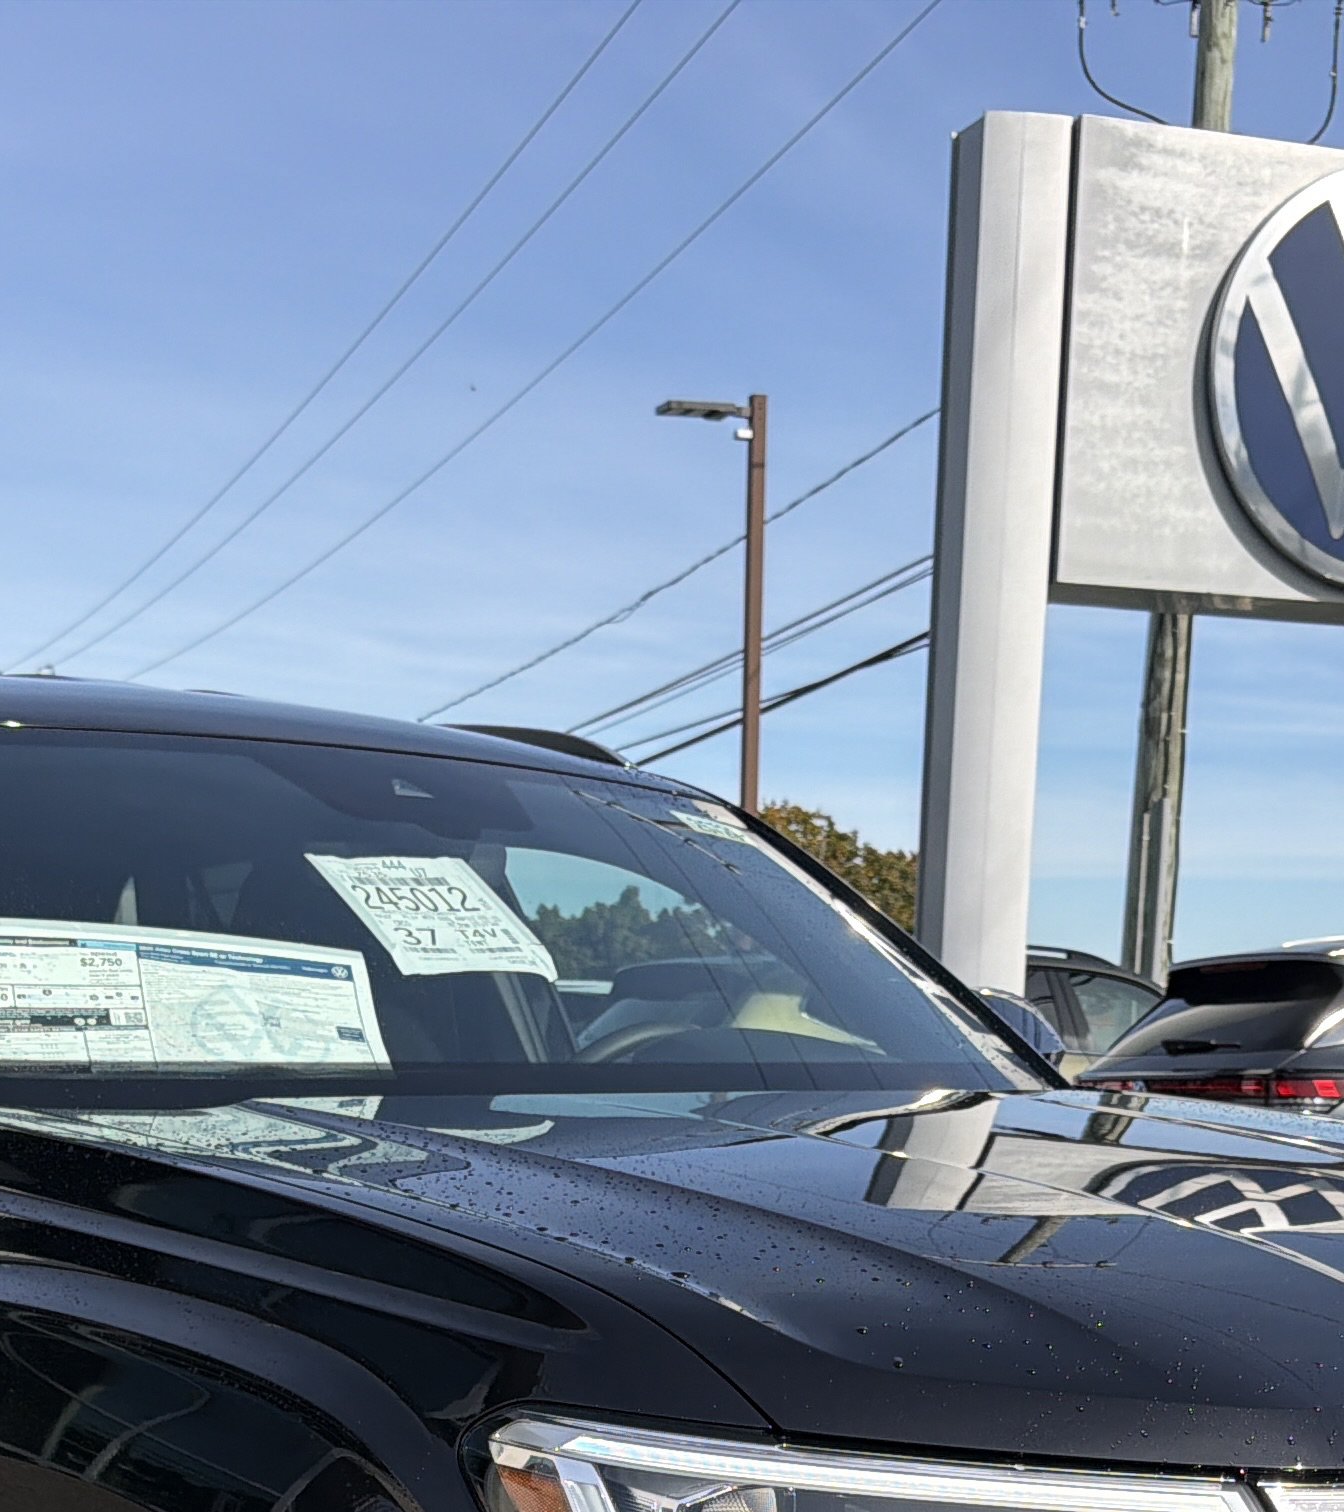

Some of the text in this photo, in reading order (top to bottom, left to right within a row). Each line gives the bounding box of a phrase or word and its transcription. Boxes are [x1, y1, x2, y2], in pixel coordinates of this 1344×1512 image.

[351, 884, 481, 913] 245012
[393, 927, 437, 947] 37
[80, 957, 123, 968] $2,750
